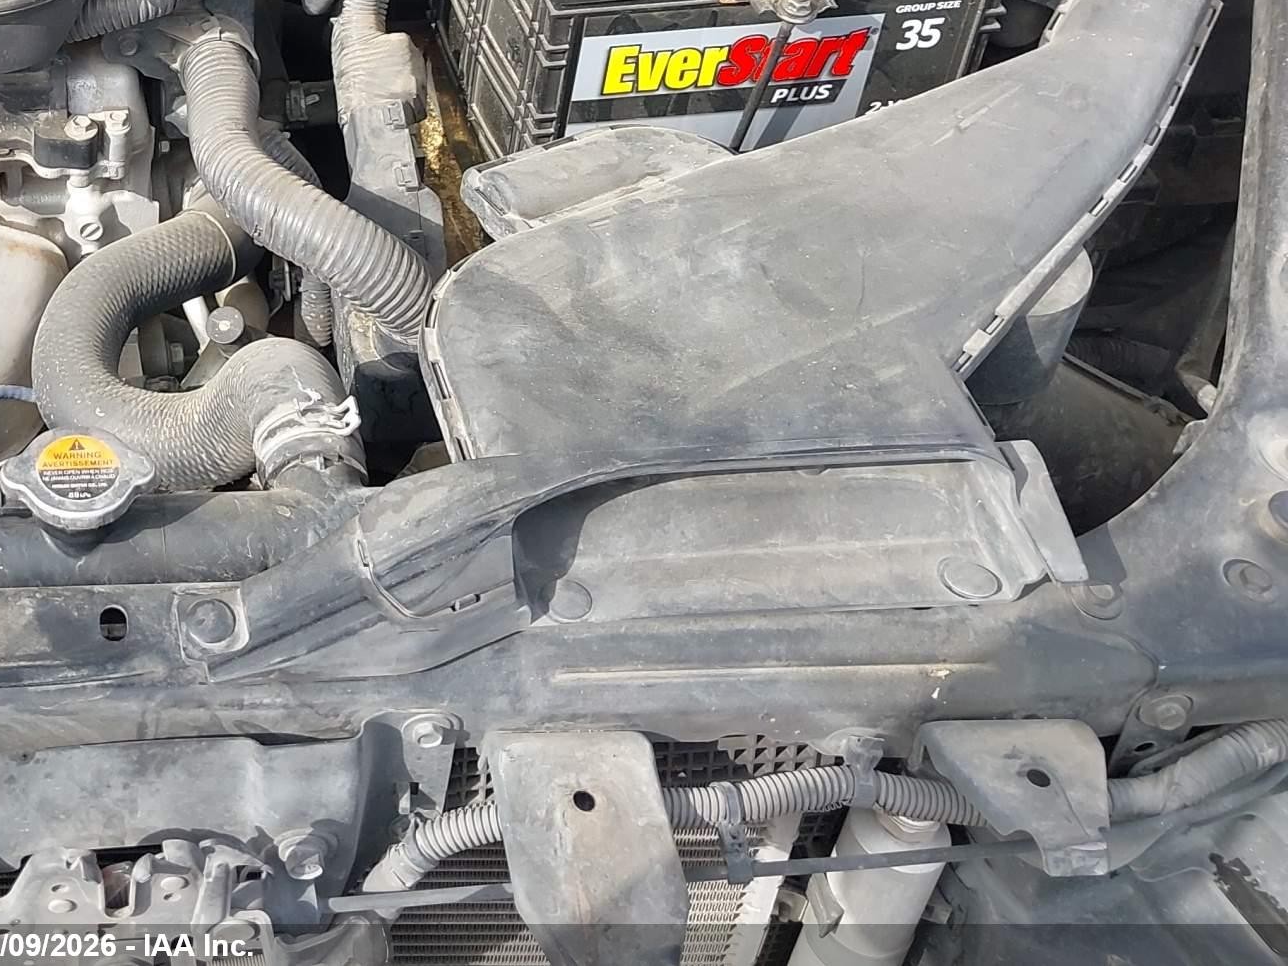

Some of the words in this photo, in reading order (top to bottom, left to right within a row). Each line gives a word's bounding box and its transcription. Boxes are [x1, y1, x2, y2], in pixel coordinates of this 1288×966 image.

[895, 2, 936, 14] GROUP
[936, 0, 962, 10] SIZE
[895, 17, 946, 51] 35
[770, 83, 834, 105] PLUS
[53, 451, 102, 459] WARNING
[42, 459, 113, 468] AVERTISSEMENT
